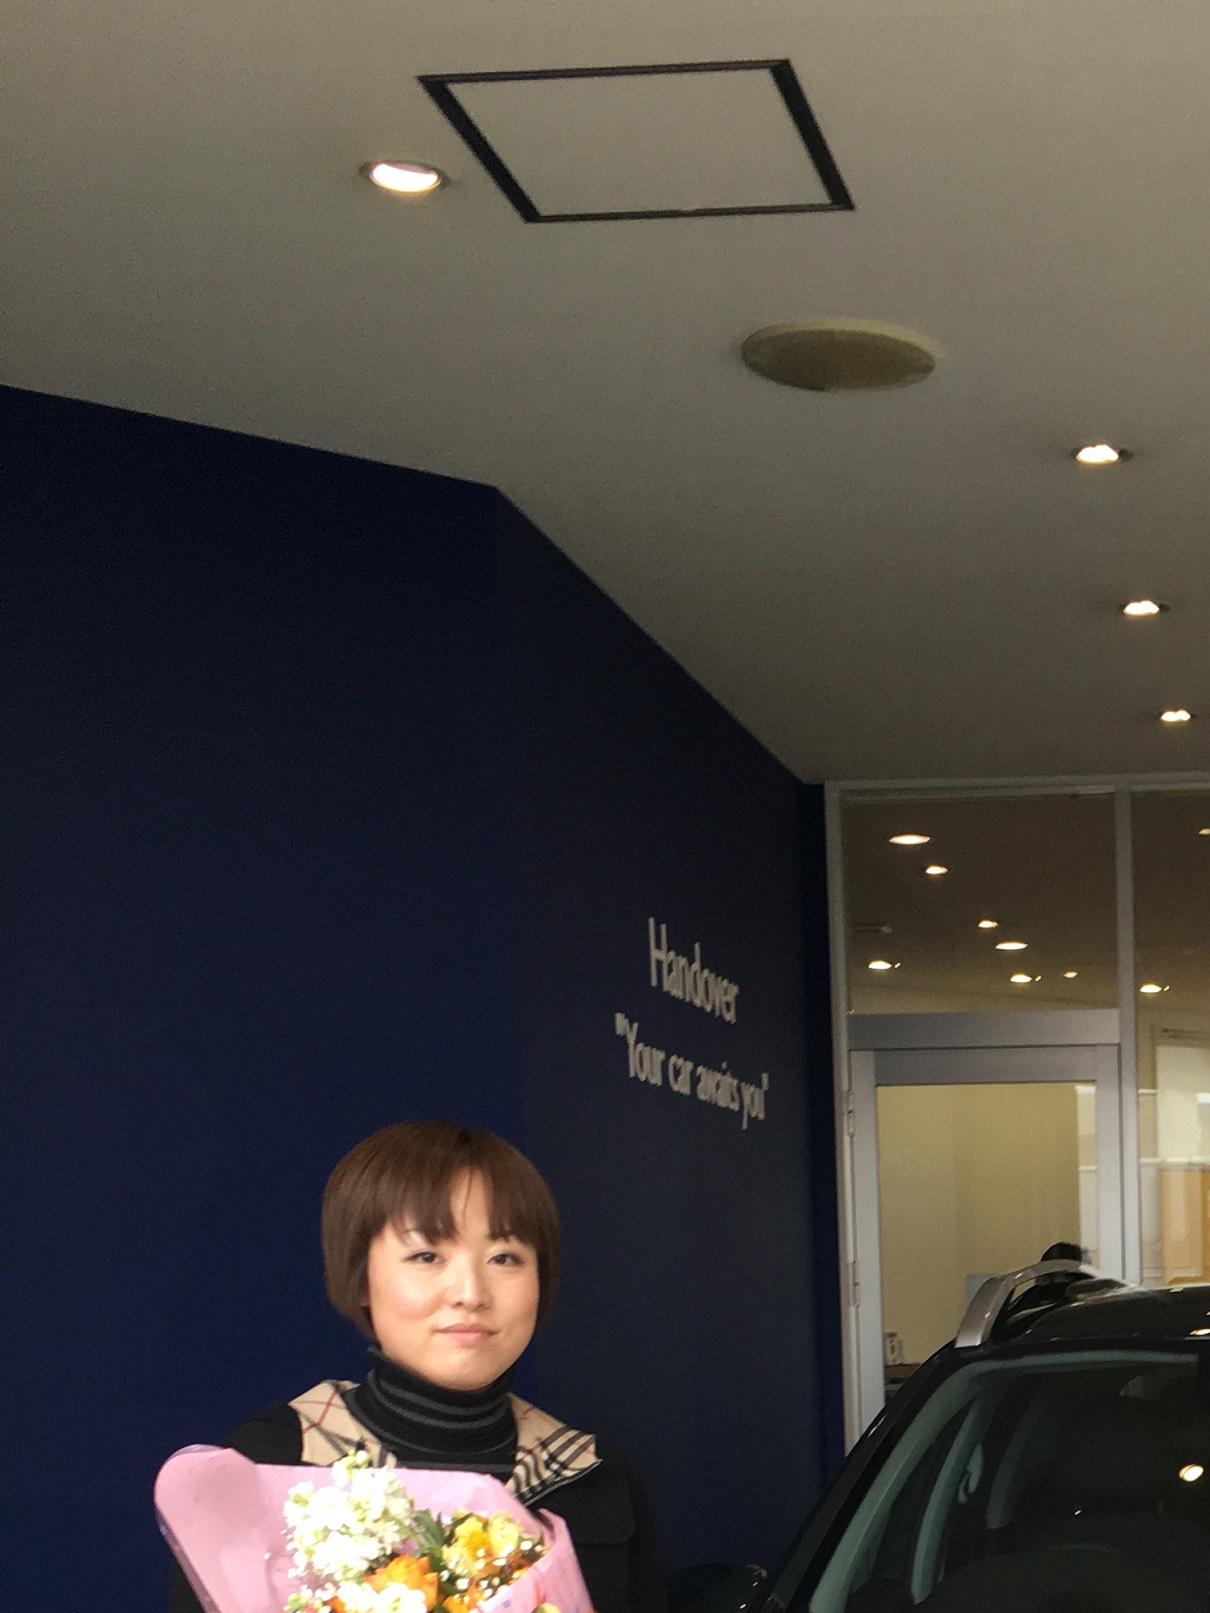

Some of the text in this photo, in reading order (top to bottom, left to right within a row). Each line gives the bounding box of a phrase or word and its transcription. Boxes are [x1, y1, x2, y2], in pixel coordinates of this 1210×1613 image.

[648, 916, 739, 1024] Handover
[668, 1054, 694, 1096] car
[696, 1061, 740, 1112] awaits
